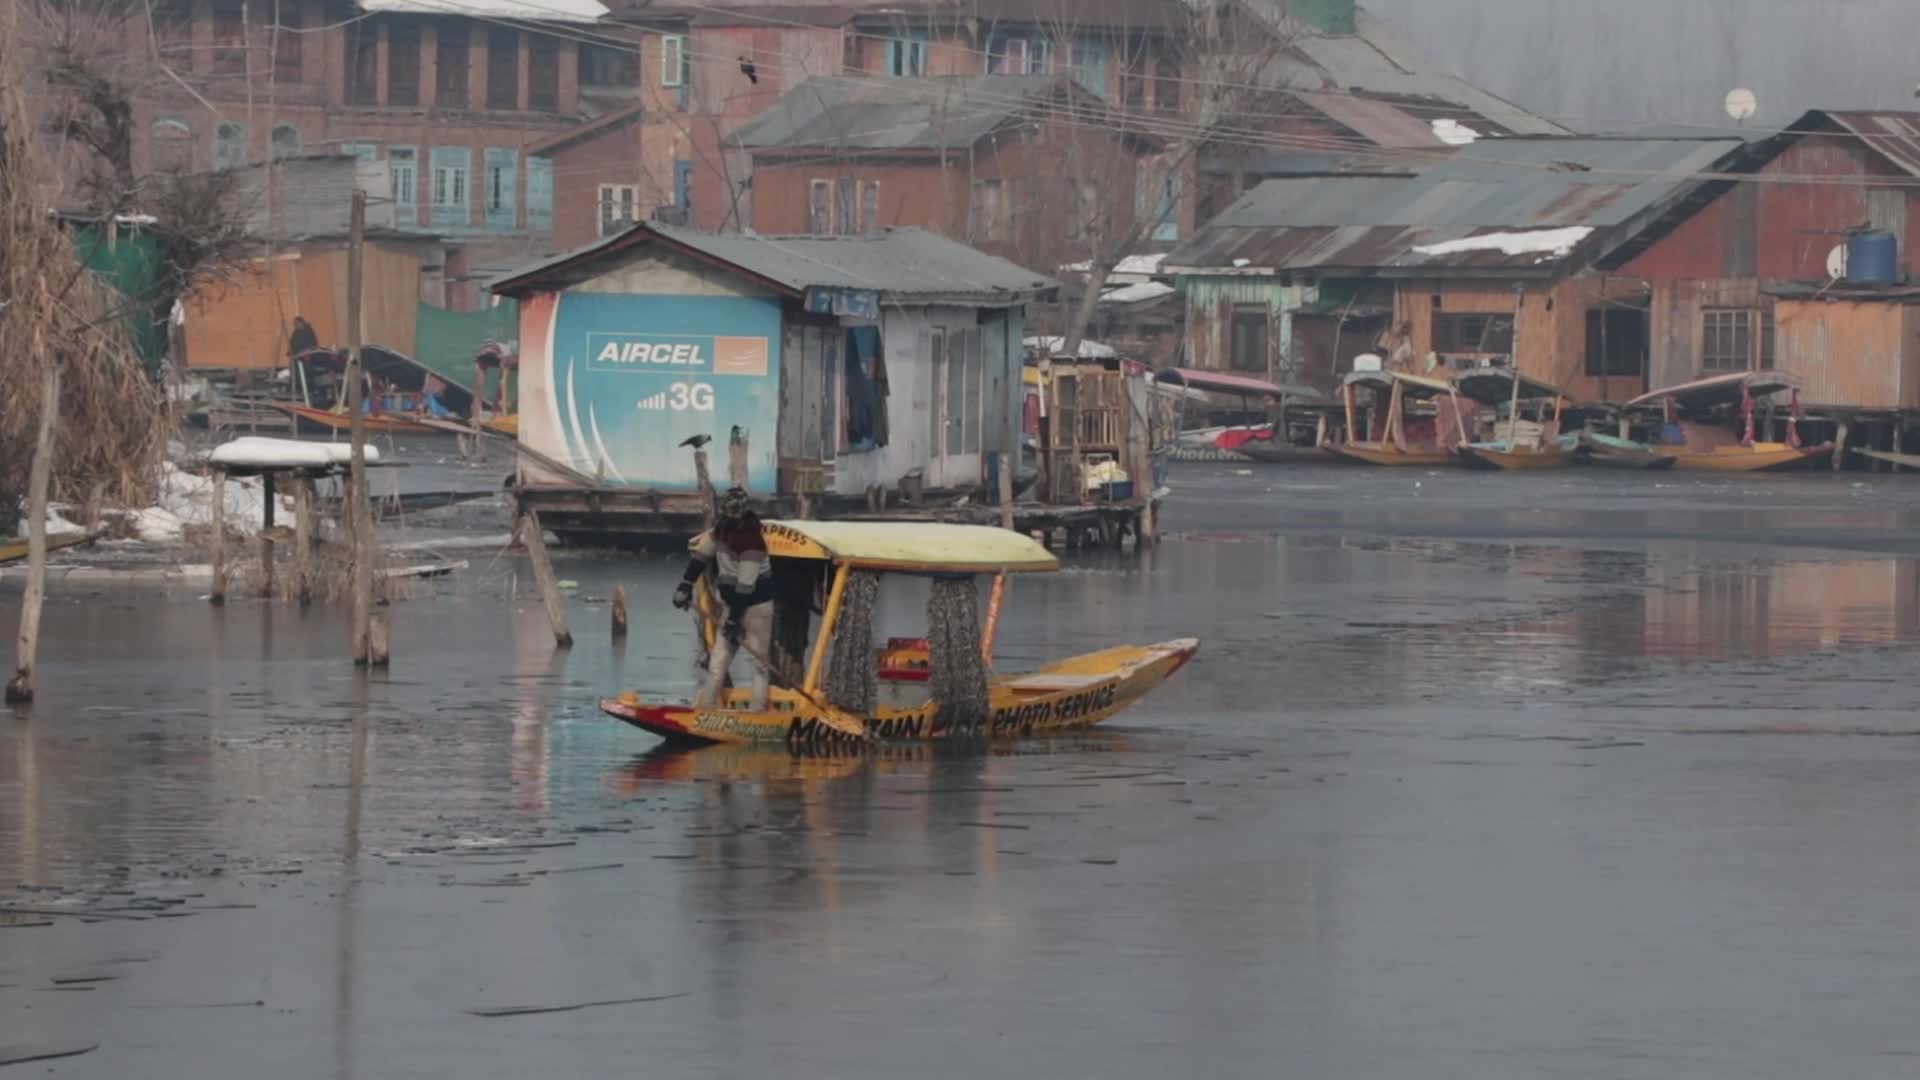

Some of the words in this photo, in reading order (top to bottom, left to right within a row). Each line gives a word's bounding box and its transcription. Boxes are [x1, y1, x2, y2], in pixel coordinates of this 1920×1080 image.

[597, 341, 705, 365] AIRCEL
[669, 382, 715, 411] 3G
[992, 702, 1051, 731] PHOTO
[1054, 682, 1116, 720] SERVICE
